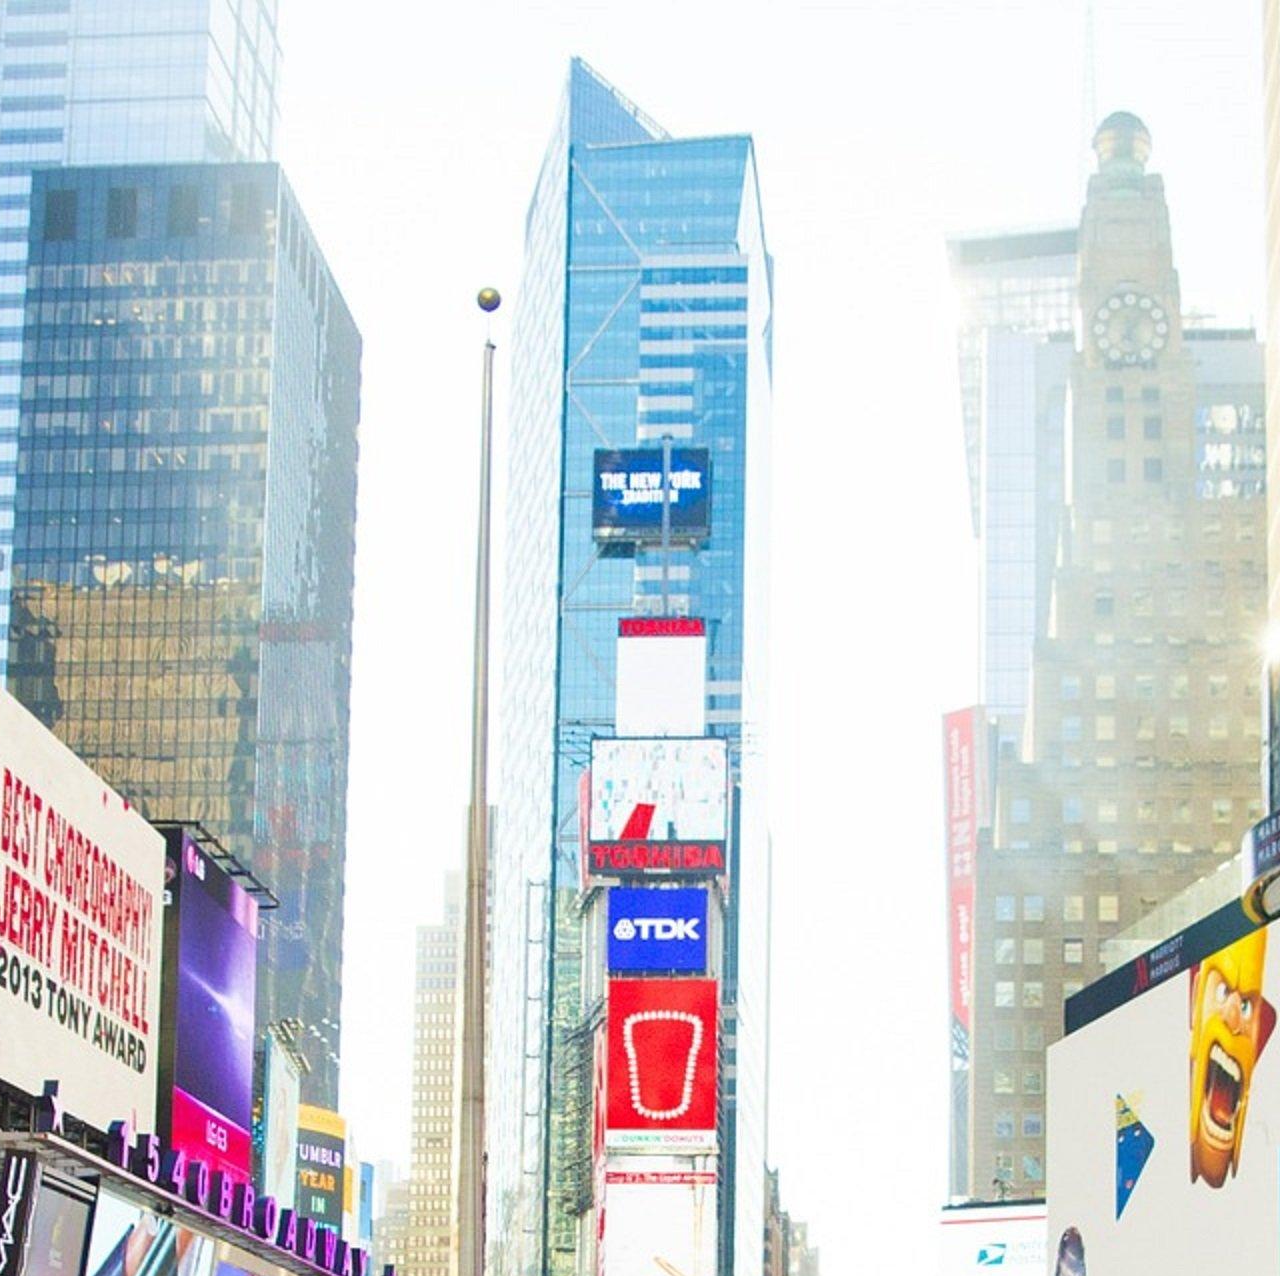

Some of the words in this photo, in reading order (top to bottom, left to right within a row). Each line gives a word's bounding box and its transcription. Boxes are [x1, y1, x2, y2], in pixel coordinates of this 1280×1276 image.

[629, 472, 662, 491] NEW
[622, 489, 679, 505] TRADITIN
[1, 766, 43, 877] BEST
[46, 806, 153, 966] CHOREOGRAPHY!
[591, 844, 725, 869] TOSHIBA
[634, 918, 701, 941] TDK
[60, 908, 151, 1036] MITCHELL
[46, 974, 92, 1040] TONY
[93, 1006, 147, 1076] AWARD
[297, 1143, 342, 1169] UMBLR
[299, 1169, 337, 1192] YEAR
[311, 1195, 327, 1214] IN
